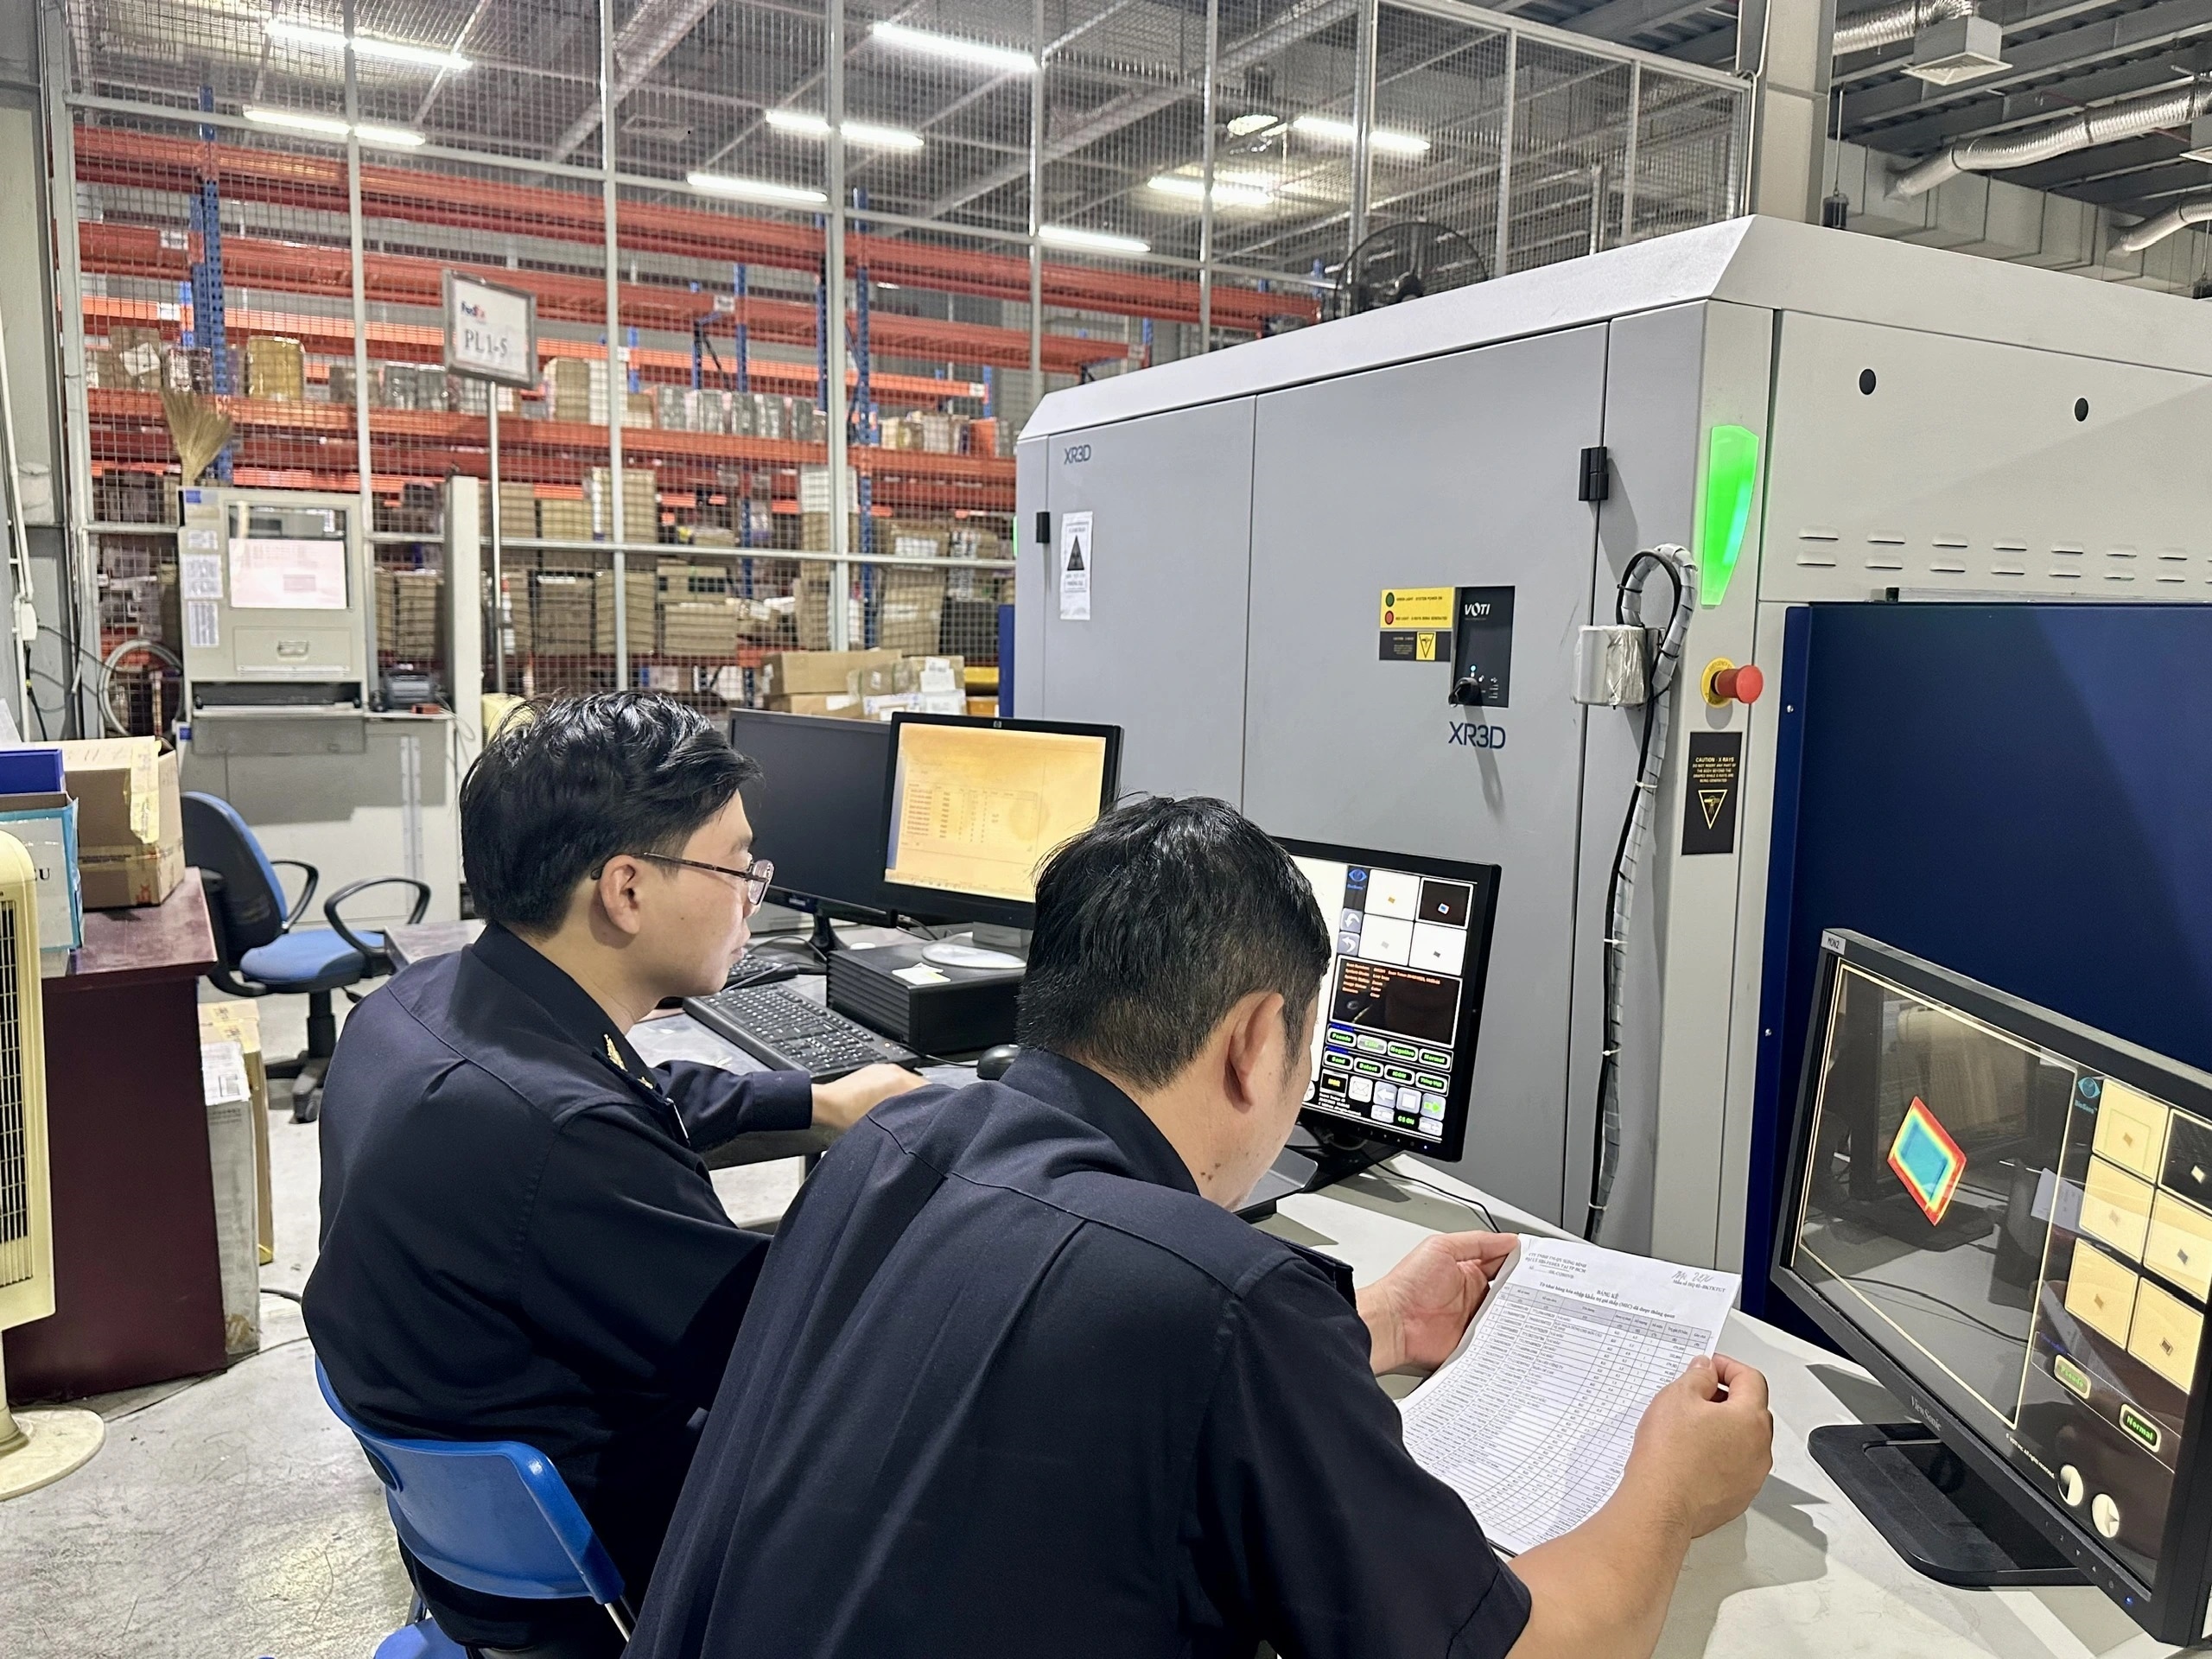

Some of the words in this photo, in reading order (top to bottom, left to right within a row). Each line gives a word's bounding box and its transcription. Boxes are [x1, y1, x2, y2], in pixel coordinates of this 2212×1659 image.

[1064, 444, 1092, 465] XR3D
[1465, 602, 1491, 616] VOTI
[1448, 721, 1506, 749] XR3D
[1424, 1054, 1446, 1064] Normal
[2060, 1365, 2084, 1388] Pseudo
[1911, 1395, 1942, 1431] ViewSonic
[2126, 1415, 2153, 1440] Normal
